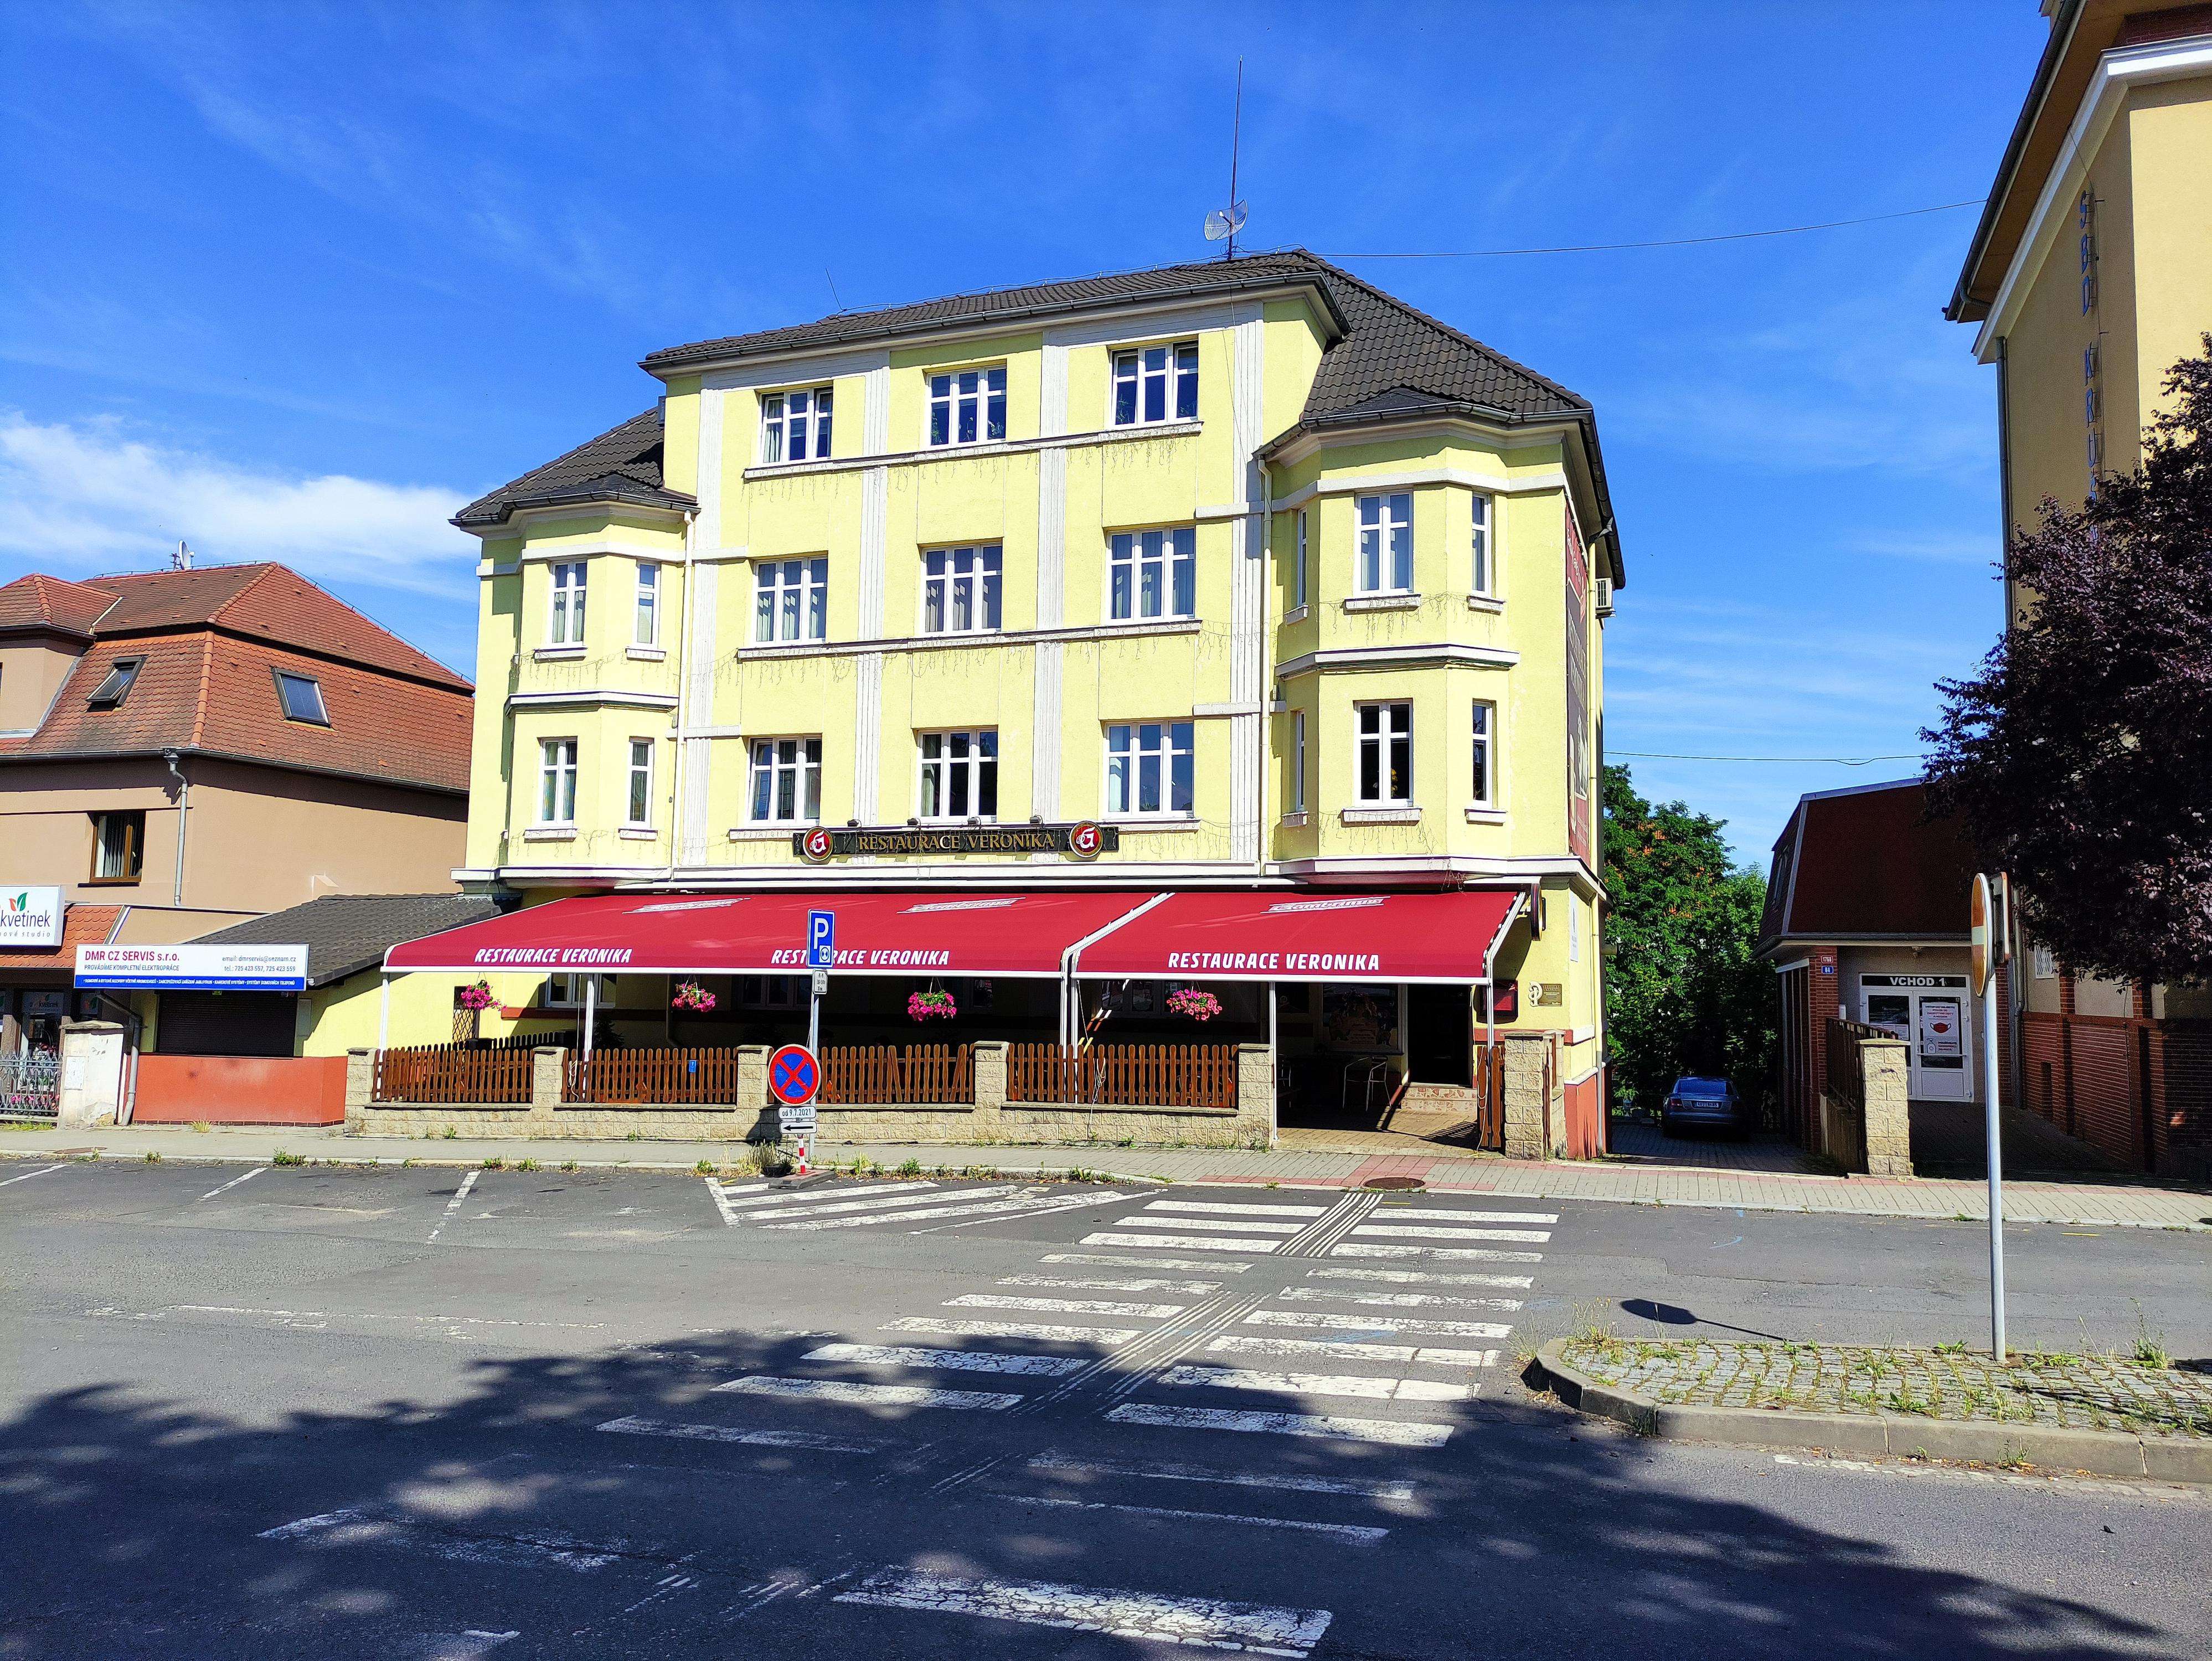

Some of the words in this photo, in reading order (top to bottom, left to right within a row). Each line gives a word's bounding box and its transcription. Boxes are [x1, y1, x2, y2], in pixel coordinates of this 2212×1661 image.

[859, 835, 960, 850] RESTAURACE
[967, 833, 1055, 849] VERONIKA
[0, 910, 51, 927] kvetinek
[813, 917, 829, 950] P
[85, 951, 105, 961] DMR
[108, 951, 120, 961] CZ
[122, 951, 155, 961] SERVIS
[238, 955, 296, 963] dmrservis@seznam.cz
[475, 948, 561, 963] RESTAURACE
[561, 948, 633, 963] VERONIKA
[771, 950, 867, 964] RESTRACE
[870, 950, 950, 965] VERONIKA
[1168, 952, 1280, 969] RESTAURACE
[1286, 953, 1380, 971] VERONIKA
[1889, 977, 1935, 986] VCHOD
[1938, 977, 1945, 987] 1
[789, 1108, 811, 1117] 9.7.2021
